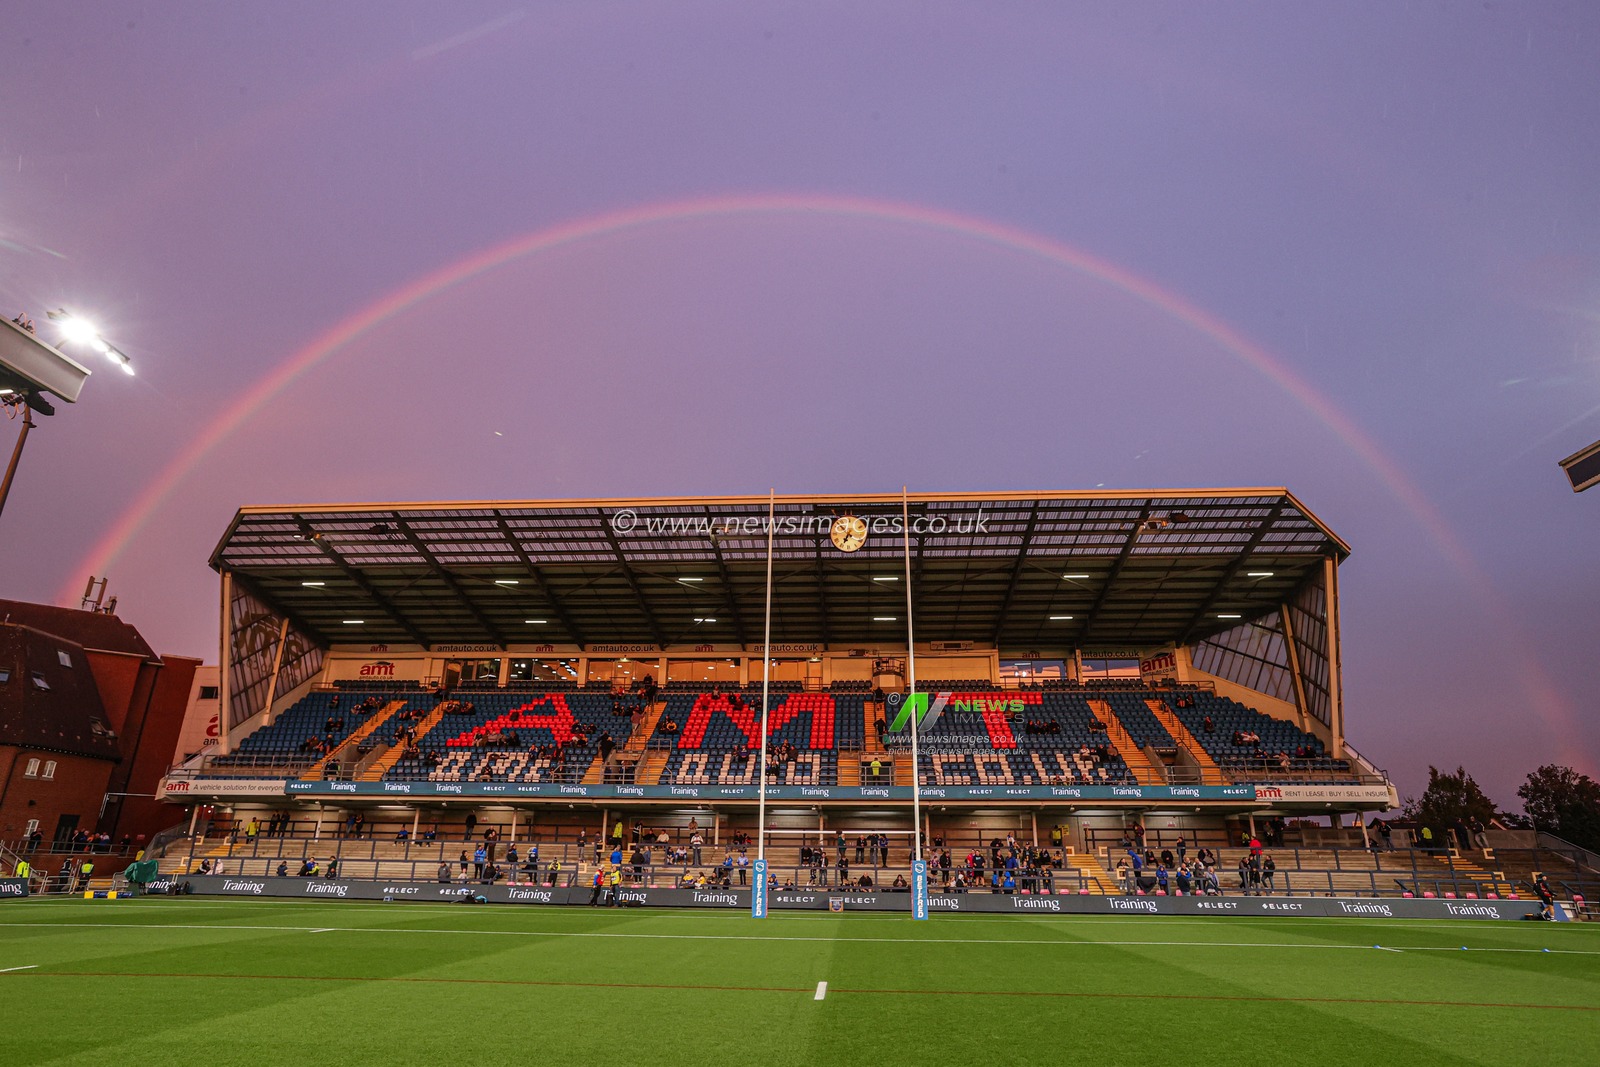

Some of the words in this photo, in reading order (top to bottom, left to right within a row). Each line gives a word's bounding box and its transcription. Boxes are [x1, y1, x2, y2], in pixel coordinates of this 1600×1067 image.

[360, 662, 395, 676] amt
[1141, 652, 1176, 672] amt
[166, 782, 190, 791] amt
[331, 782, 356, 793] Training
[384, 782, 411, 793] Training
[436, 783, 462, 794] Training
[560, 784, 587, 796] Training
[616, 785, 644, 796] Training
[671, 786, 698, 797] Training
[801, 787, 829, 797] Training
[861, 787, 889, 797] Training
[1051, 787, 1080, 797] Training
[1112, 787, 1142, 797] Training
[1169, 787, 1200, 797] Training
[1256, 788, 1282, 797] amt
[223, 880, 265, 893] Training
[306, 881, 348, 896] Training
[508, 888, 552, 902] Training
[603, 890, 647, 904] Tining
[693, 891, 738, 905] Training
[1011, 897, 1060, 910] Training
[1107, 898, 1157, 912] Training
[1338, 902, 1393, 916] Training
[1443, 903, 1500, 918] Training
[755, 874, 763, 916] BETFRED
